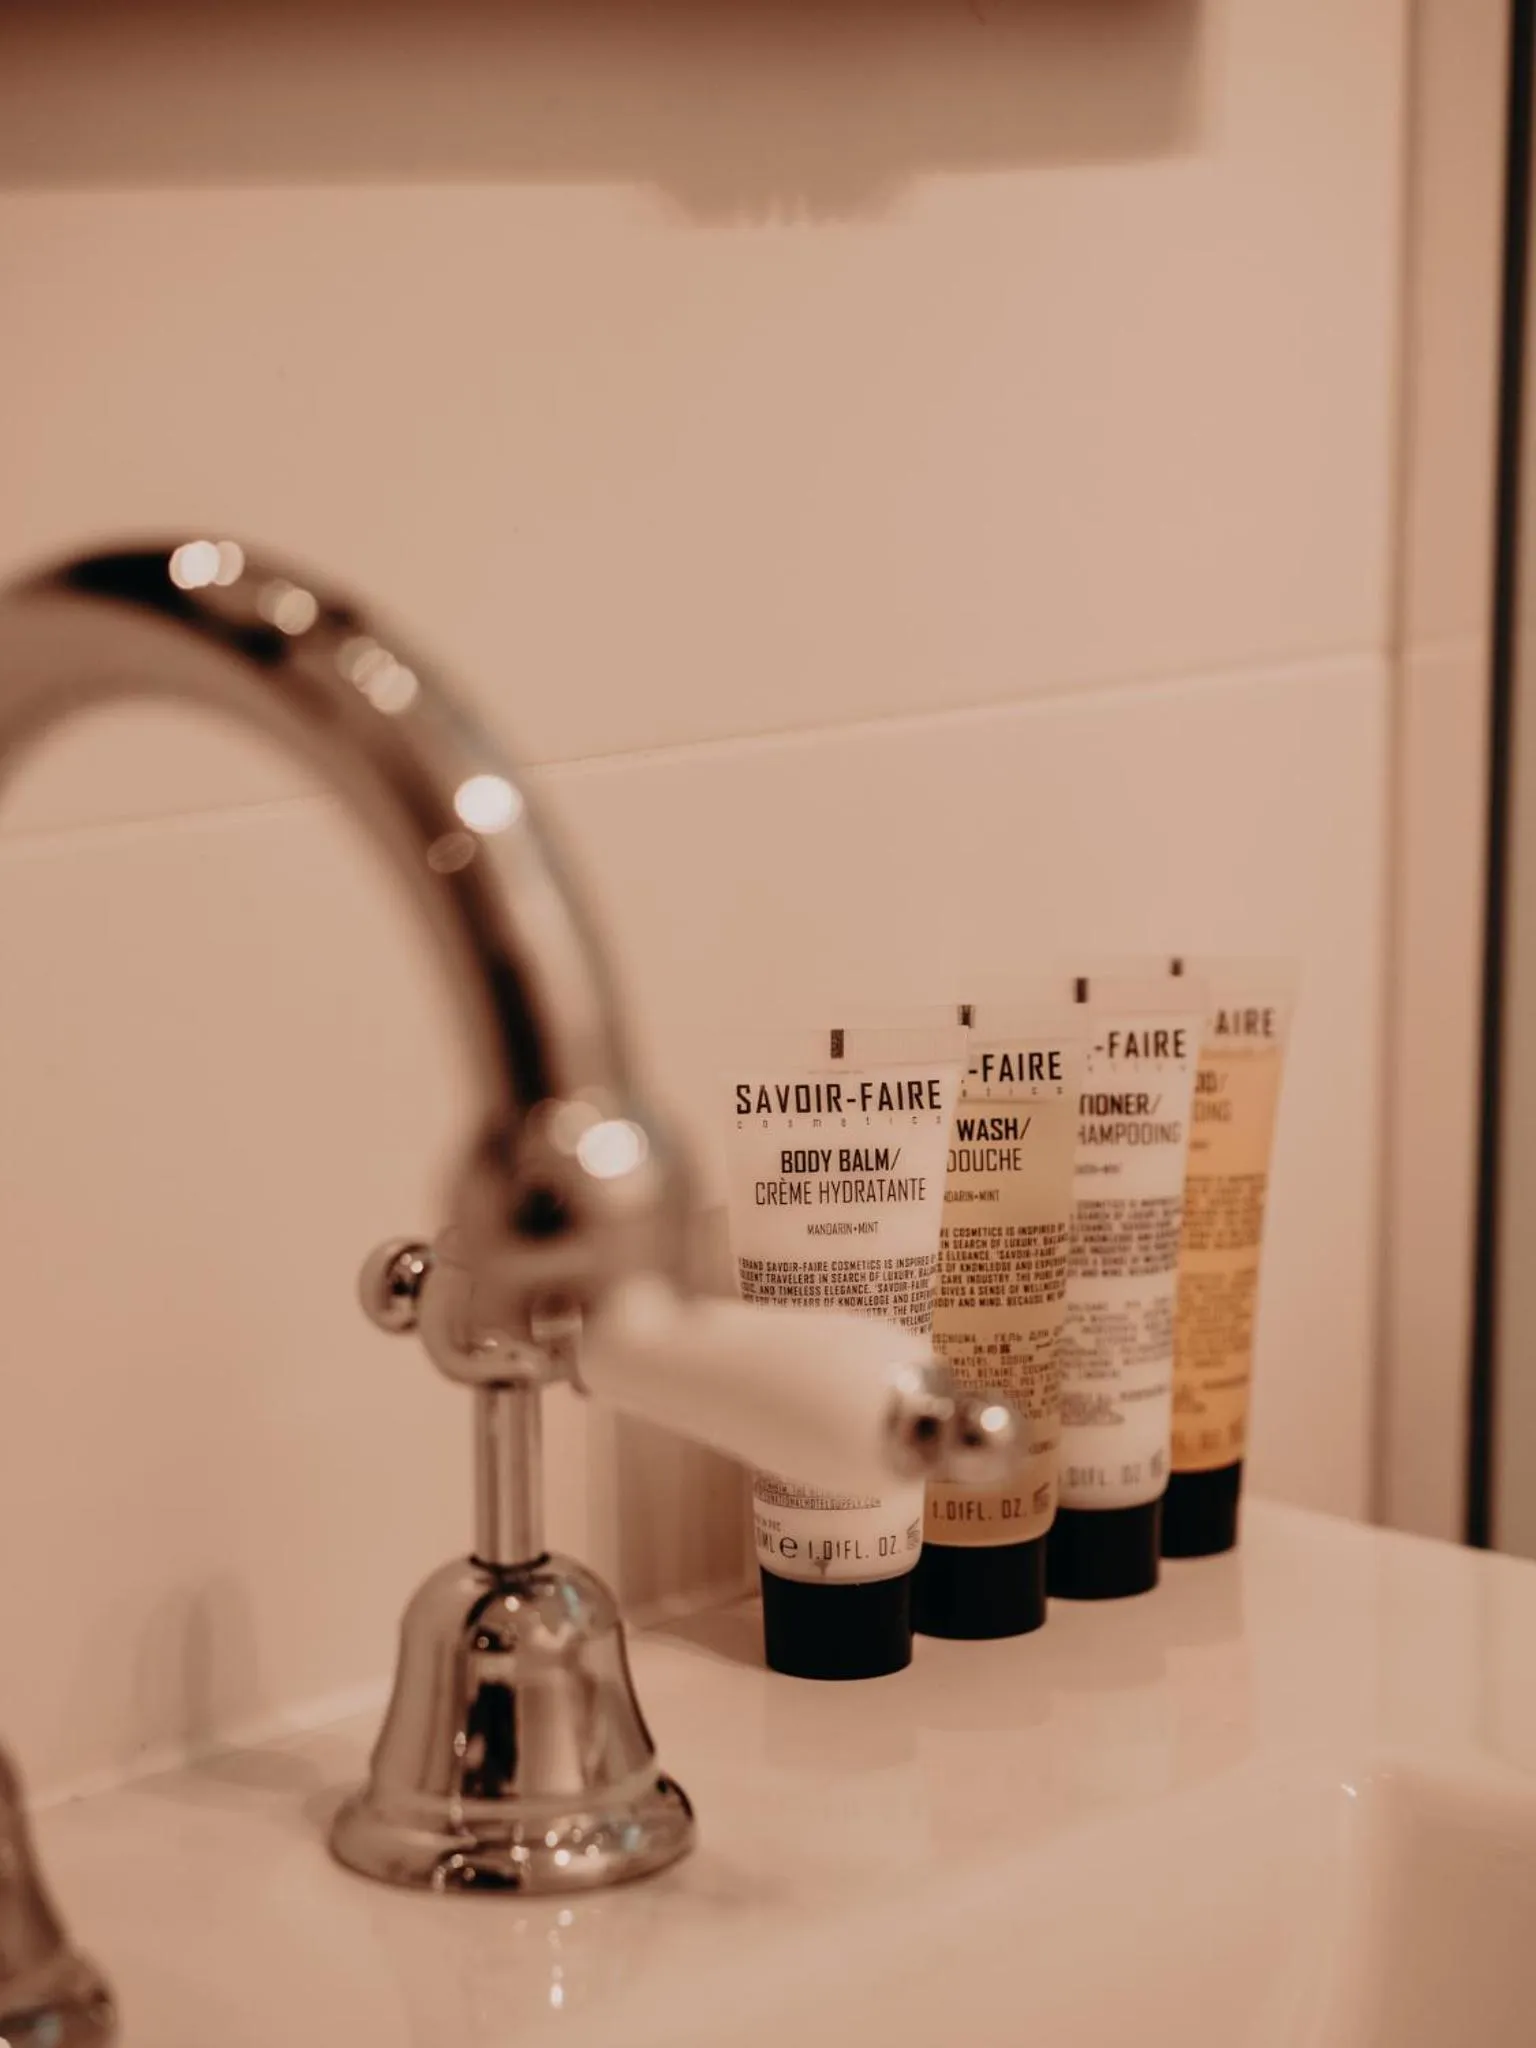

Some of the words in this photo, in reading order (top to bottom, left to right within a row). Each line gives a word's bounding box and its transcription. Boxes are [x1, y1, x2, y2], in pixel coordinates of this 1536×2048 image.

[1215, 1007, 1276, 1038] AIRE
[1094, 1028, 1187, 1059] -FAIRE
[966, 1051, 1063, 1083] -FAIRE
[736, 1079, 942, 1115] SAVOIR-FAIRE
[956, 1116, 1032, 1142] WASH/
[781, 1150, 832, 1174] BODY
[839, 1148, 901, 1172] BALM/
[755, 1177, 812, 1206] CRÈME
[819, 1177, 927, 1204] HYDRATANTE
[765, 1272, 815, 1285] TRAVELERS
[817, 1273, 829, 1284] IN
[831, 1271, 866, 1283] SEARCH
[766, 1261, 828, 1272] SAVOIR-FAIRE
[830, 1259, 881, 1272] COSMETICS
[778, 1285, 822, 1297] TIMELESS
